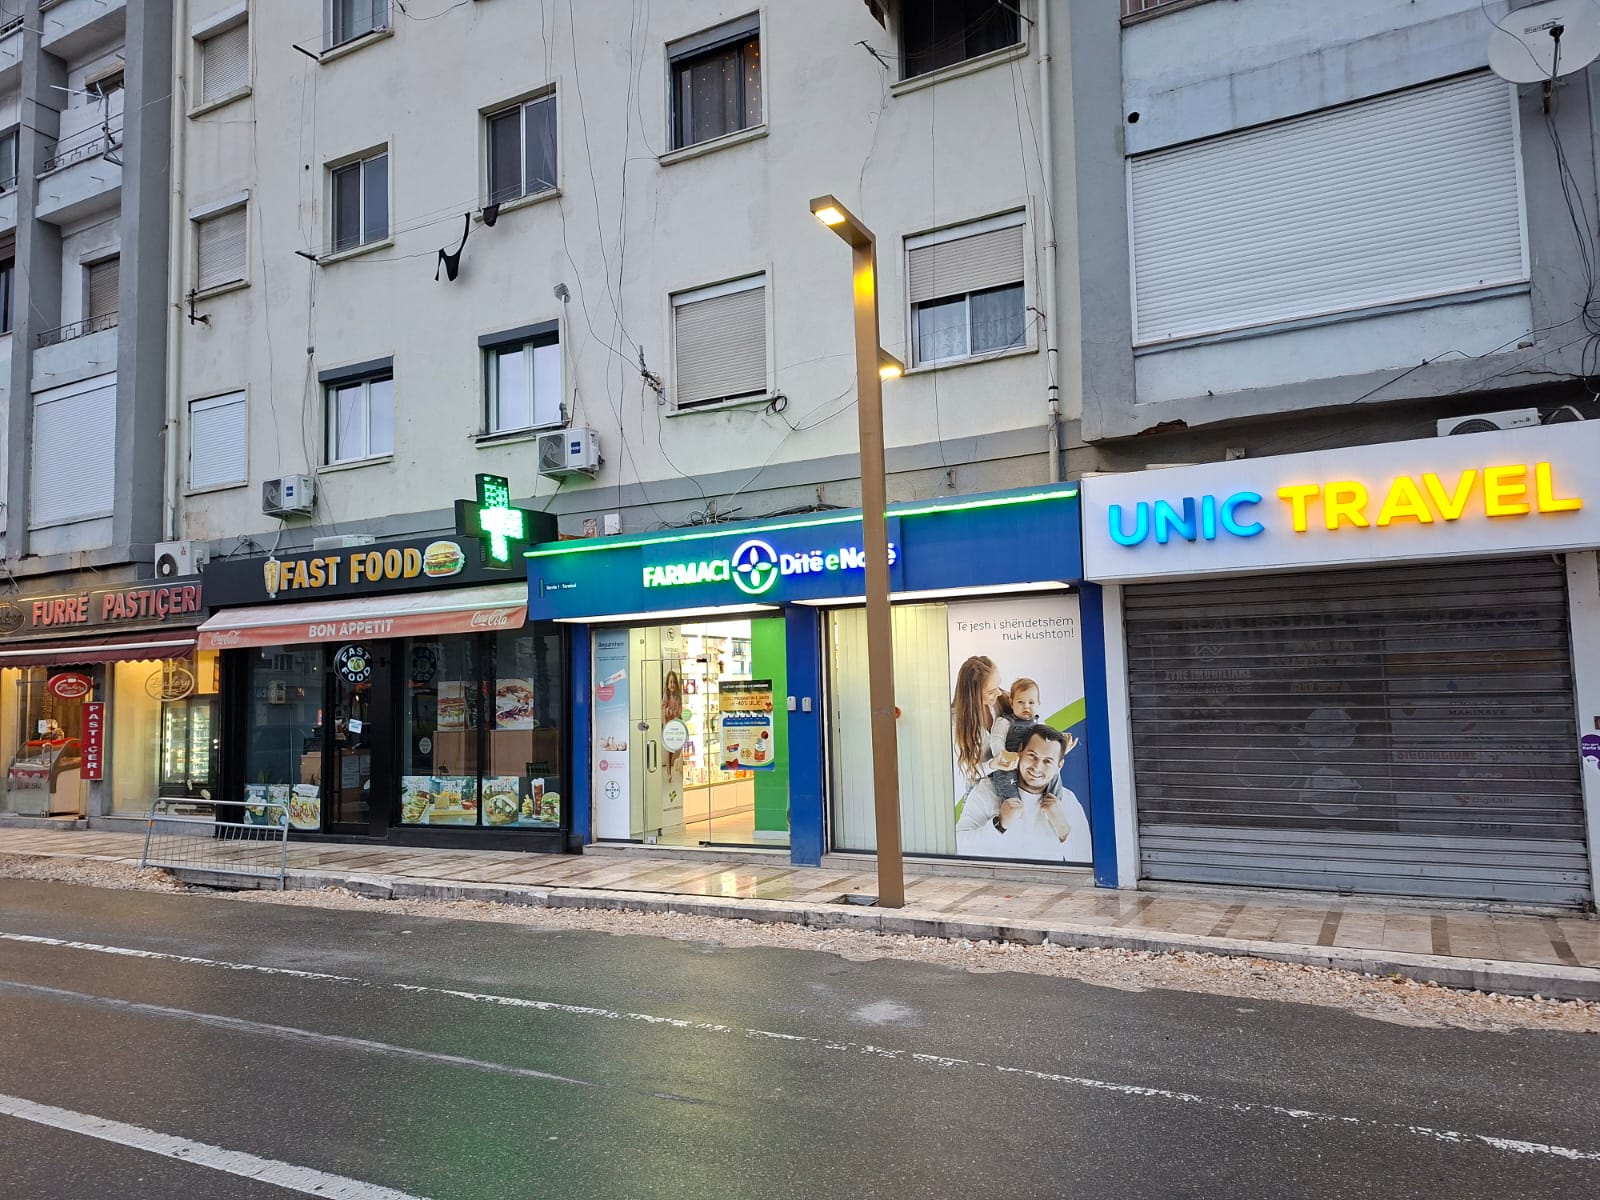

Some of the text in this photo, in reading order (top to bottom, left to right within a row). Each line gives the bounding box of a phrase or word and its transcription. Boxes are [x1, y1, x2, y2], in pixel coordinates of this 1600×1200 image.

[1108, 461, 1584, 547] UNIC TRAVEL
[279, 547, 422, 591] FAST FOOD
[642, 559, 731, 588] FARMACI
[780, 550, 824, 576] Ditë
[825, 554, 839, 570] e
[32, 584, 203, 627] FURRË PASTIÇERI
[309, 619, 394, 638] BON APPETIT
[969, 619, 991, 633] jesh
[993, 619, 997, 630] i
[1002, 627, 1075, 641] nuk kushton!
[341, 647, 371, 663] FAST
[341, 666, 371, 682] FOOD
